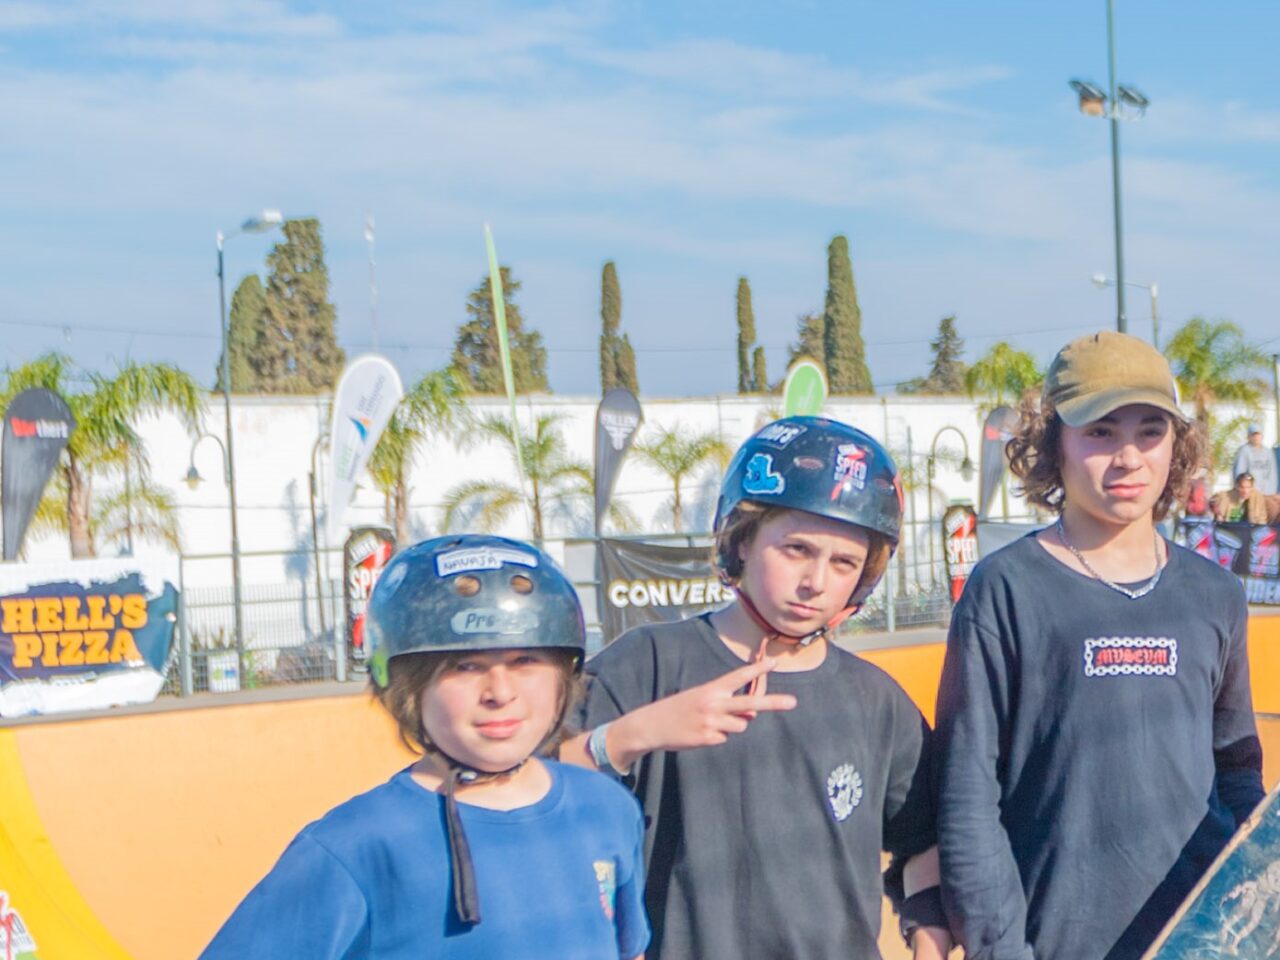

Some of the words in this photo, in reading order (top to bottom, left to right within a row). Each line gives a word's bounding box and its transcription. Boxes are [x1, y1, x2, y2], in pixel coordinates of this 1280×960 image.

[1, 593, 148, 633] HELL'S
[608, 579, 736, 608] CONVERS
[12, 628, 145, 668] PIZZA
